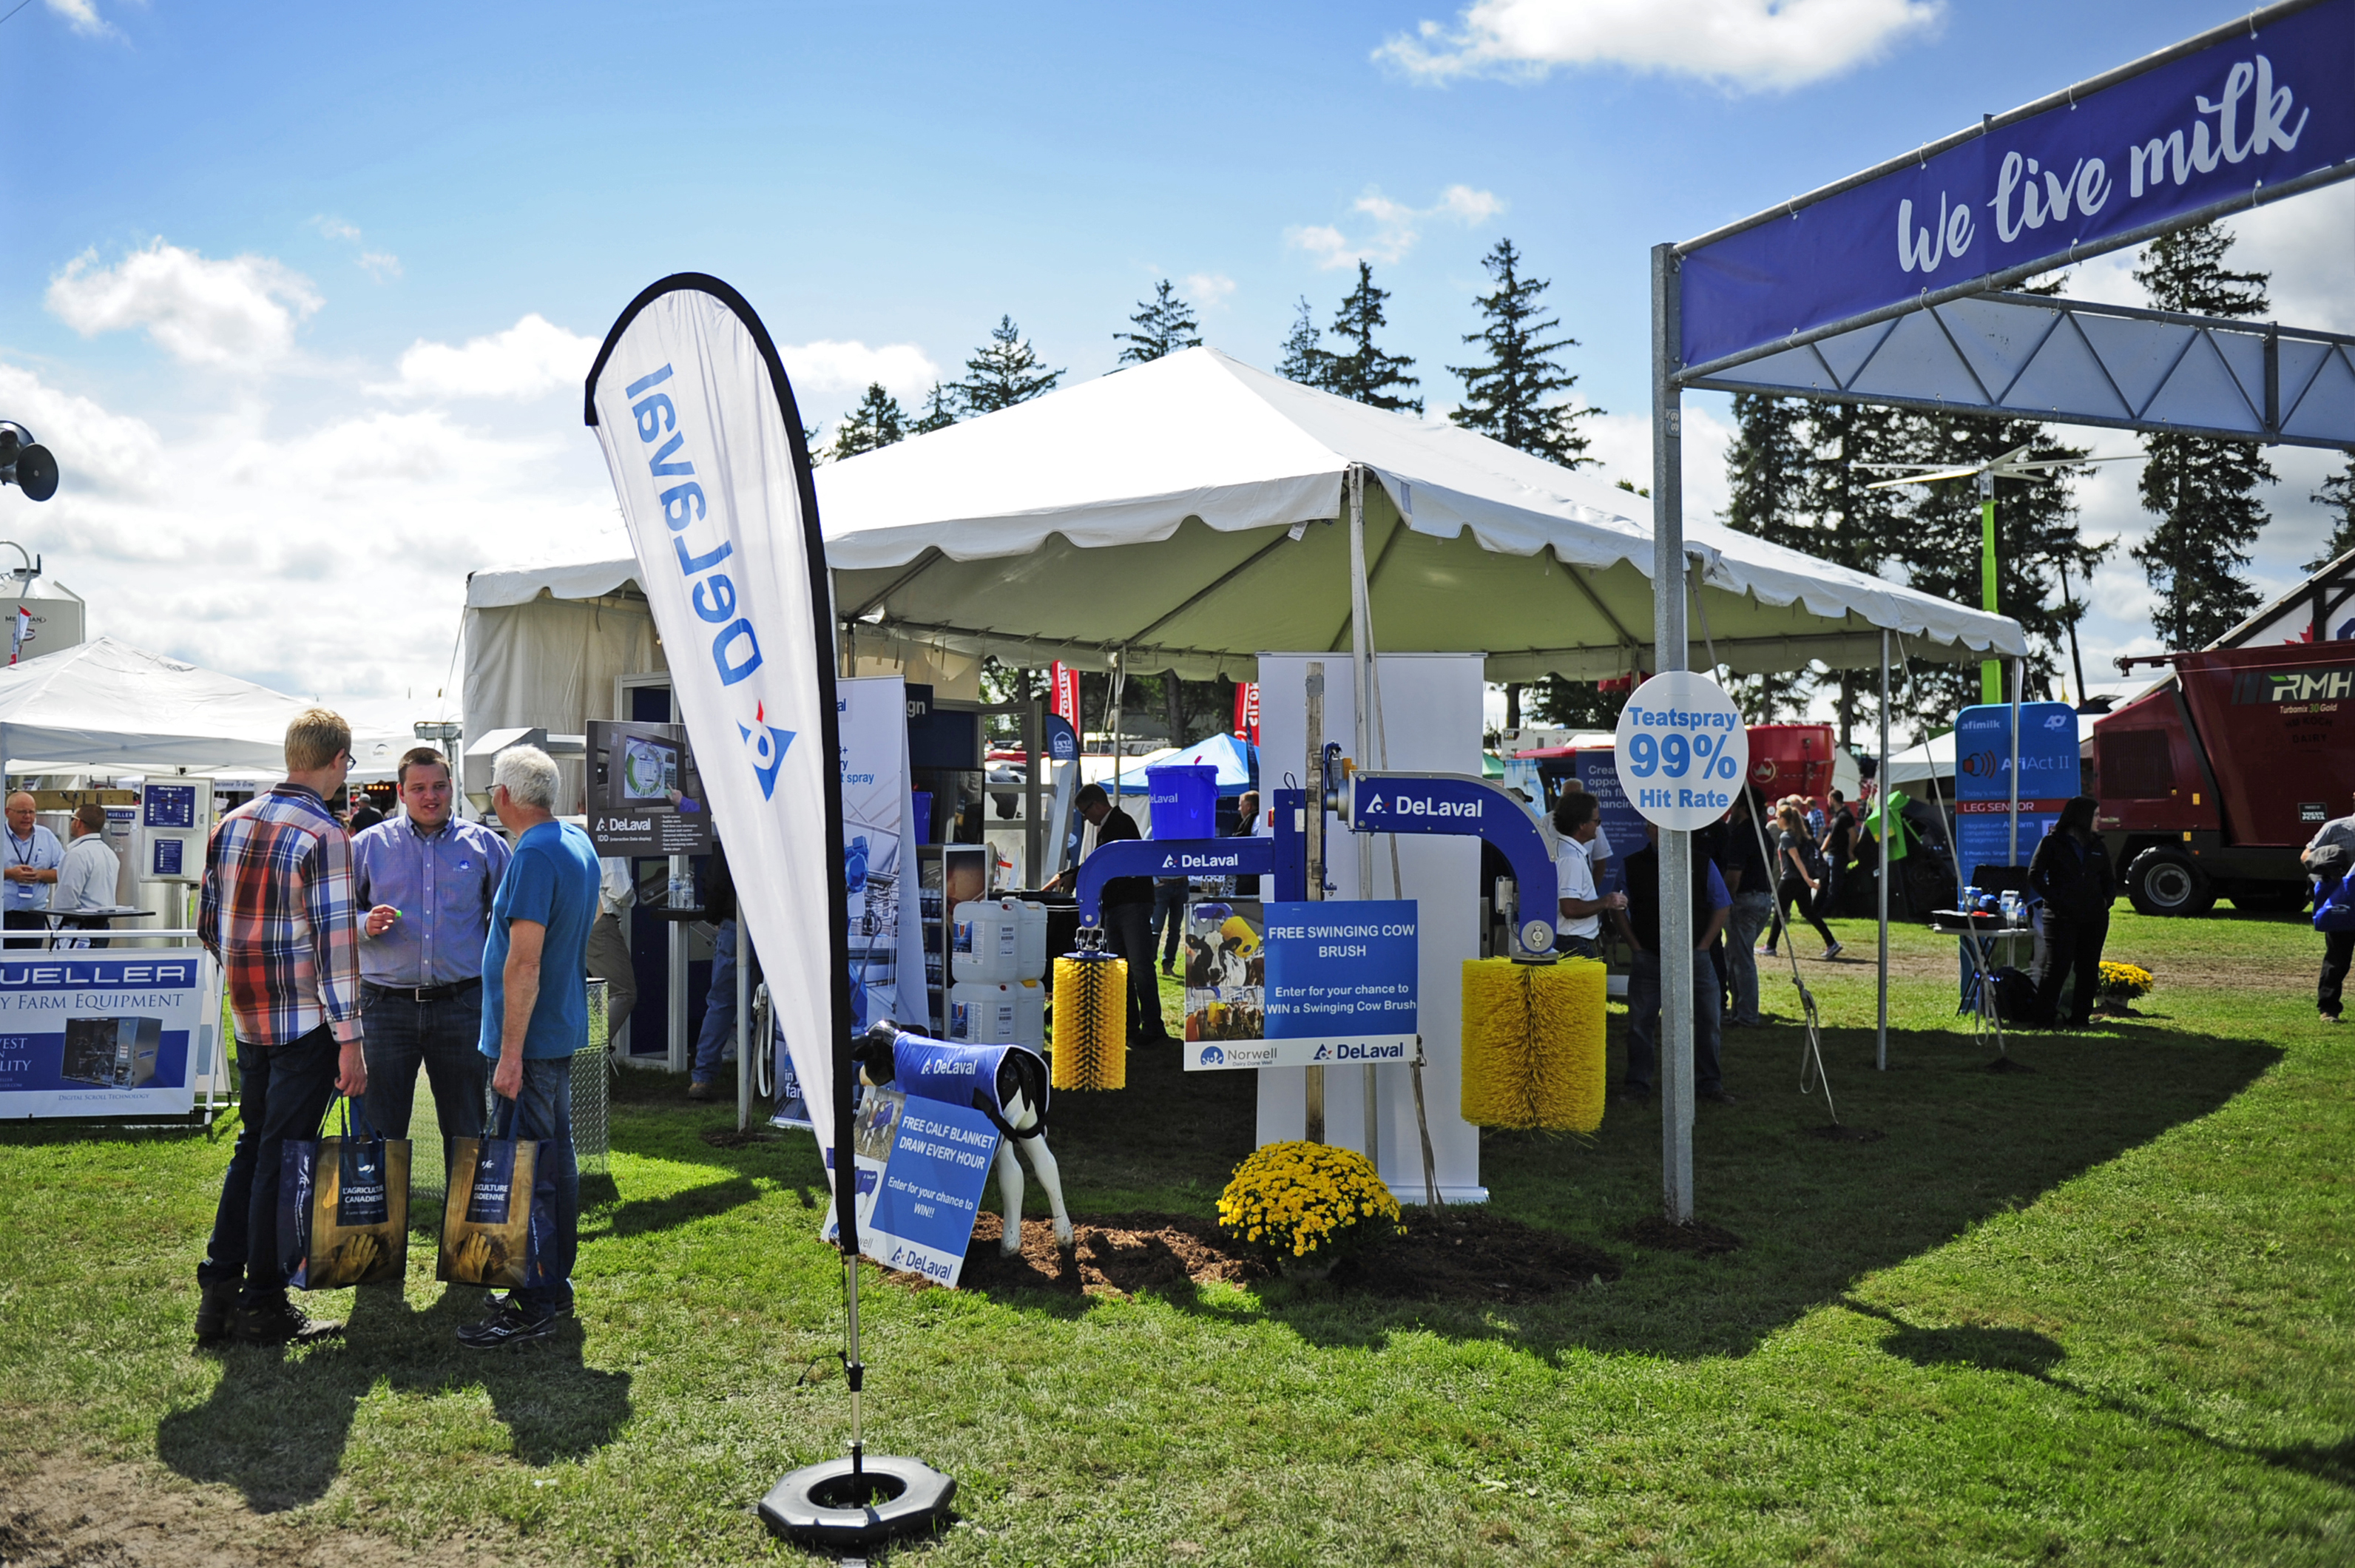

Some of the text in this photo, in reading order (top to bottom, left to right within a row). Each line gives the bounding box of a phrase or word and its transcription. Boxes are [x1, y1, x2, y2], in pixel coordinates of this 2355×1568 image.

[1897, 55, 2310, 273] We live milk
[2268, 671, 2353, 701] RMH
[2280, 703, 2338, 714] Turbomix 30 Gold
[1628, 707, 1737, 731] Teatspray
[1962, 720, 2001, 730] afimilk
[2292, 733, 2327, 743] DAIRY
[1629, 733, 1737, 780] 99%
[2058, 756, 2070, 769] II
[847, 774, 875, 785] spray
[1588, 779, 1621, 788] oppor
[1640, 788, 1729, 808] Hit Rate
[1396, 796, 1482, 817] DeLaval
[1964, 802, 2035, 812] LEG SENOR
[609, 817, 651, 831] DeLaval
[1181, 854, 1239, 868] DeLaval
[1268, 924, 1415, 939] FREE SWINGING COW
[1319, 945, 1367, 958] BRUSH
[0, 965, 186, 985] UELLER
[1275, 984, 1409, 999] Enter for your chance to
[75, 993, 184, 1011] EQUIPMENT
[1267, 1004, 1290, 1014] WIN
[1303, 1001, 1354, 1015] Swinging
[1356, 1001, 1381, 1011] Cow
[1384, 999, 1416, 1010] Brush
[0, 1037, 28, 1050] EST
[1227, 1041, 1404, 1061] Norwell DeLaval
[0, 1060, 32, 1072] LITY
[933, 1059, 978, 1075] DeLaval
[902, 1115, 996, 1149] FREE CALF BLANKET
[899, 1136, 986, 1170] DRAW EVERY HOUR
[888, 1176, 974, 1211] Enter for your chance to
[913, 1202, 935, 1219] WIN!!
[858, 1237, 874, 1250] well
[906, 1250, 953, 1280] DeLaval
